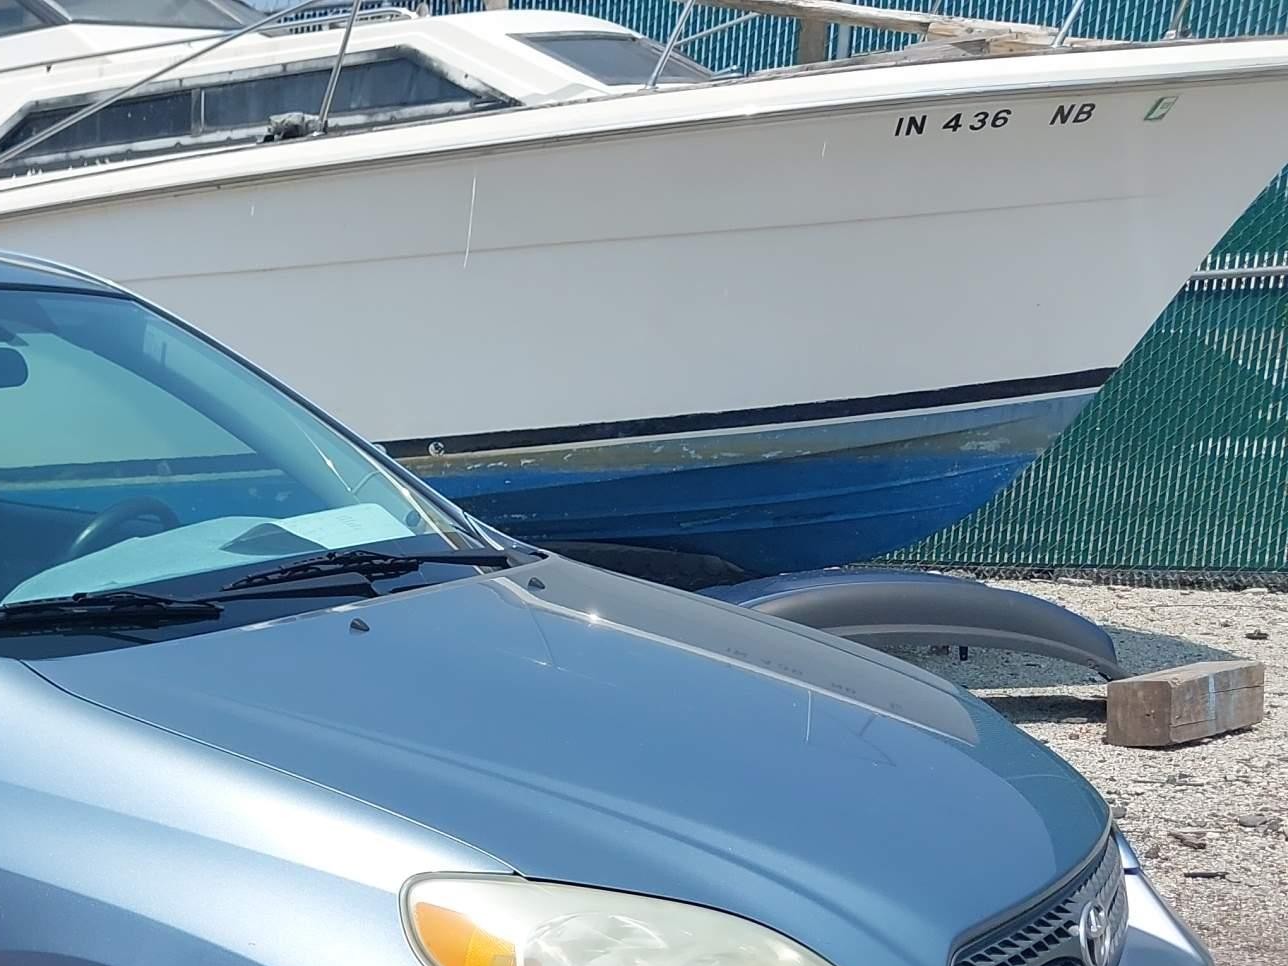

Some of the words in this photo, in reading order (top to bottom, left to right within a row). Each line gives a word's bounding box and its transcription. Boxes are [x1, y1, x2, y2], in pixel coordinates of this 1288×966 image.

[894, 114, 928, 137] IN
[941, 109, 1012, 133] 436
[1049, 102, 1096, 126] NB
